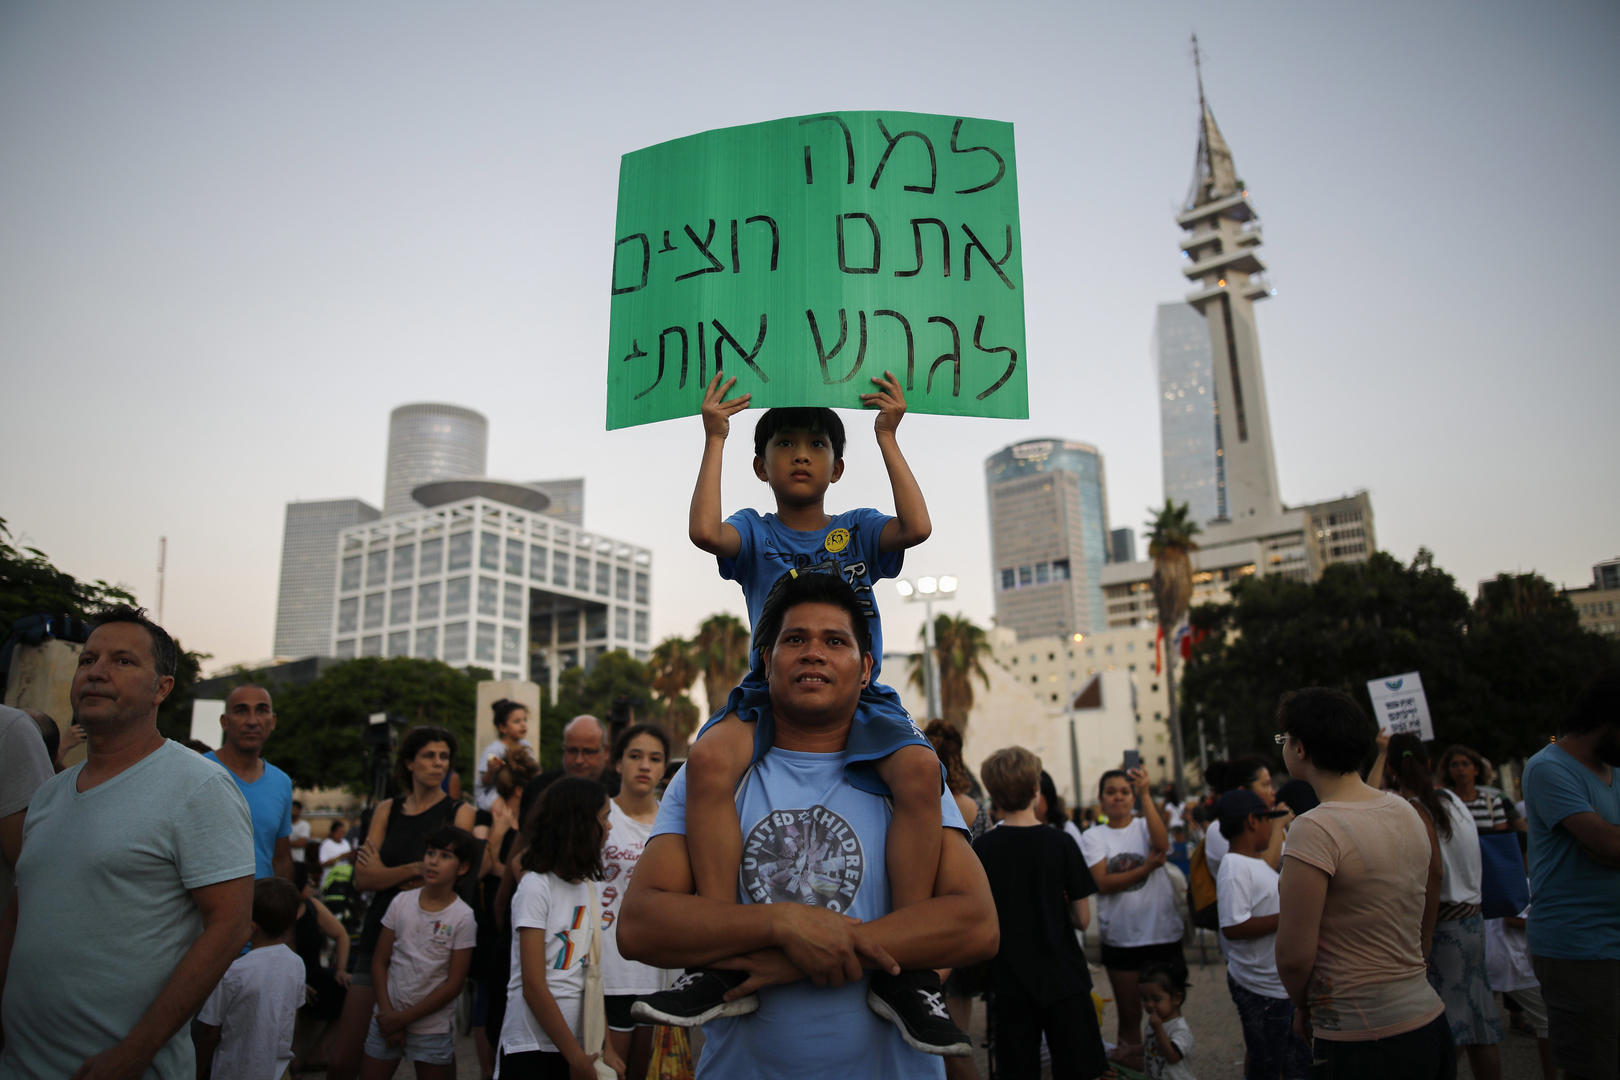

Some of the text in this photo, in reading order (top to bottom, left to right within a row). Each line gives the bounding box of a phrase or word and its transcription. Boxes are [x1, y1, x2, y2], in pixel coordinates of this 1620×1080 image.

[799, 115, 1006, 195] למה
[611, 212, 1016, 296] אתם רוצים
[623, 308, 1018, 400] לגרש אותי
[744, 812, 795, 870] UNITED
[813, 807, 861, 898] CHILDREN
